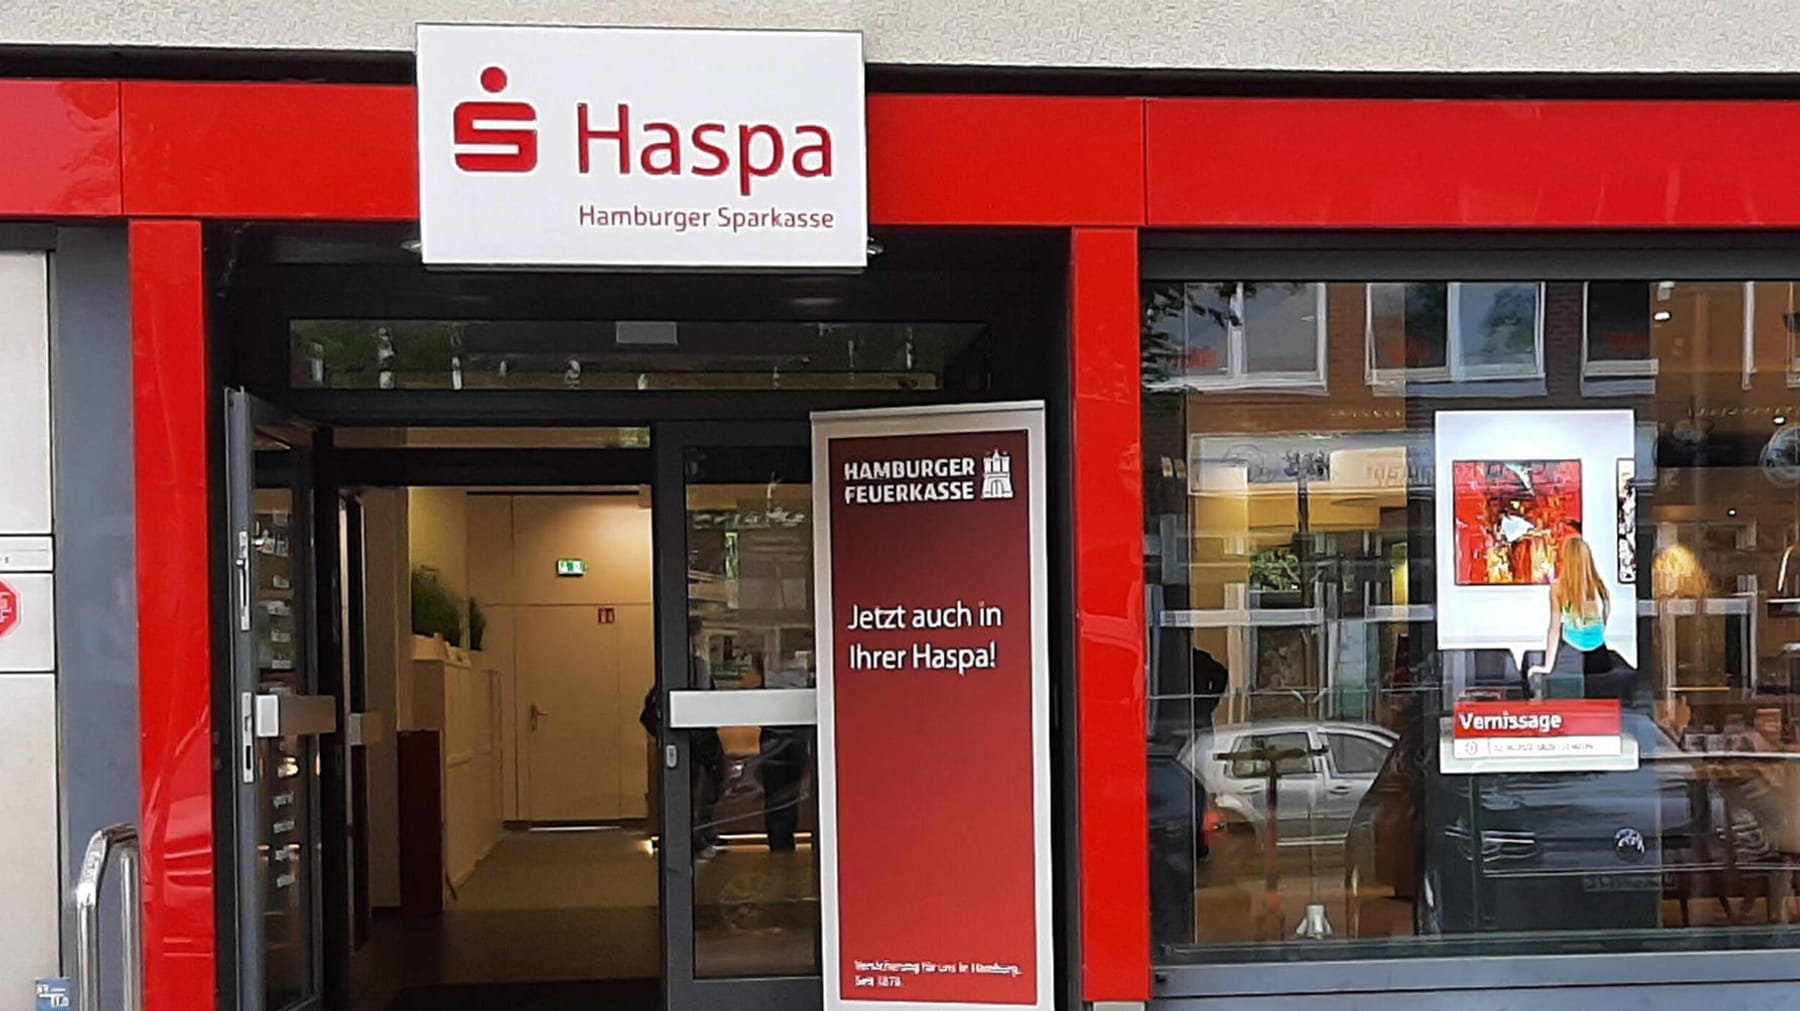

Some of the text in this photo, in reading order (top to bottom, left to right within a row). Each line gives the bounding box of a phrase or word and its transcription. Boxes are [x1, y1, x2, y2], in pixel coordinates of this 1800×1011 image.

[576, 102, 832, 196] Haspa
[578, 205, 834, 233] Hamburger Sparkasse
[843, 457, 975, 481] HAMBURGER
[844, 481, 974, 504] FEUERKASSE
[847, 601, 1003, 630] Jetzt auch in
[849, 641, 997, 676] Ihrer Haspa!
[1458, 711, 1563, 733] Vernissage
